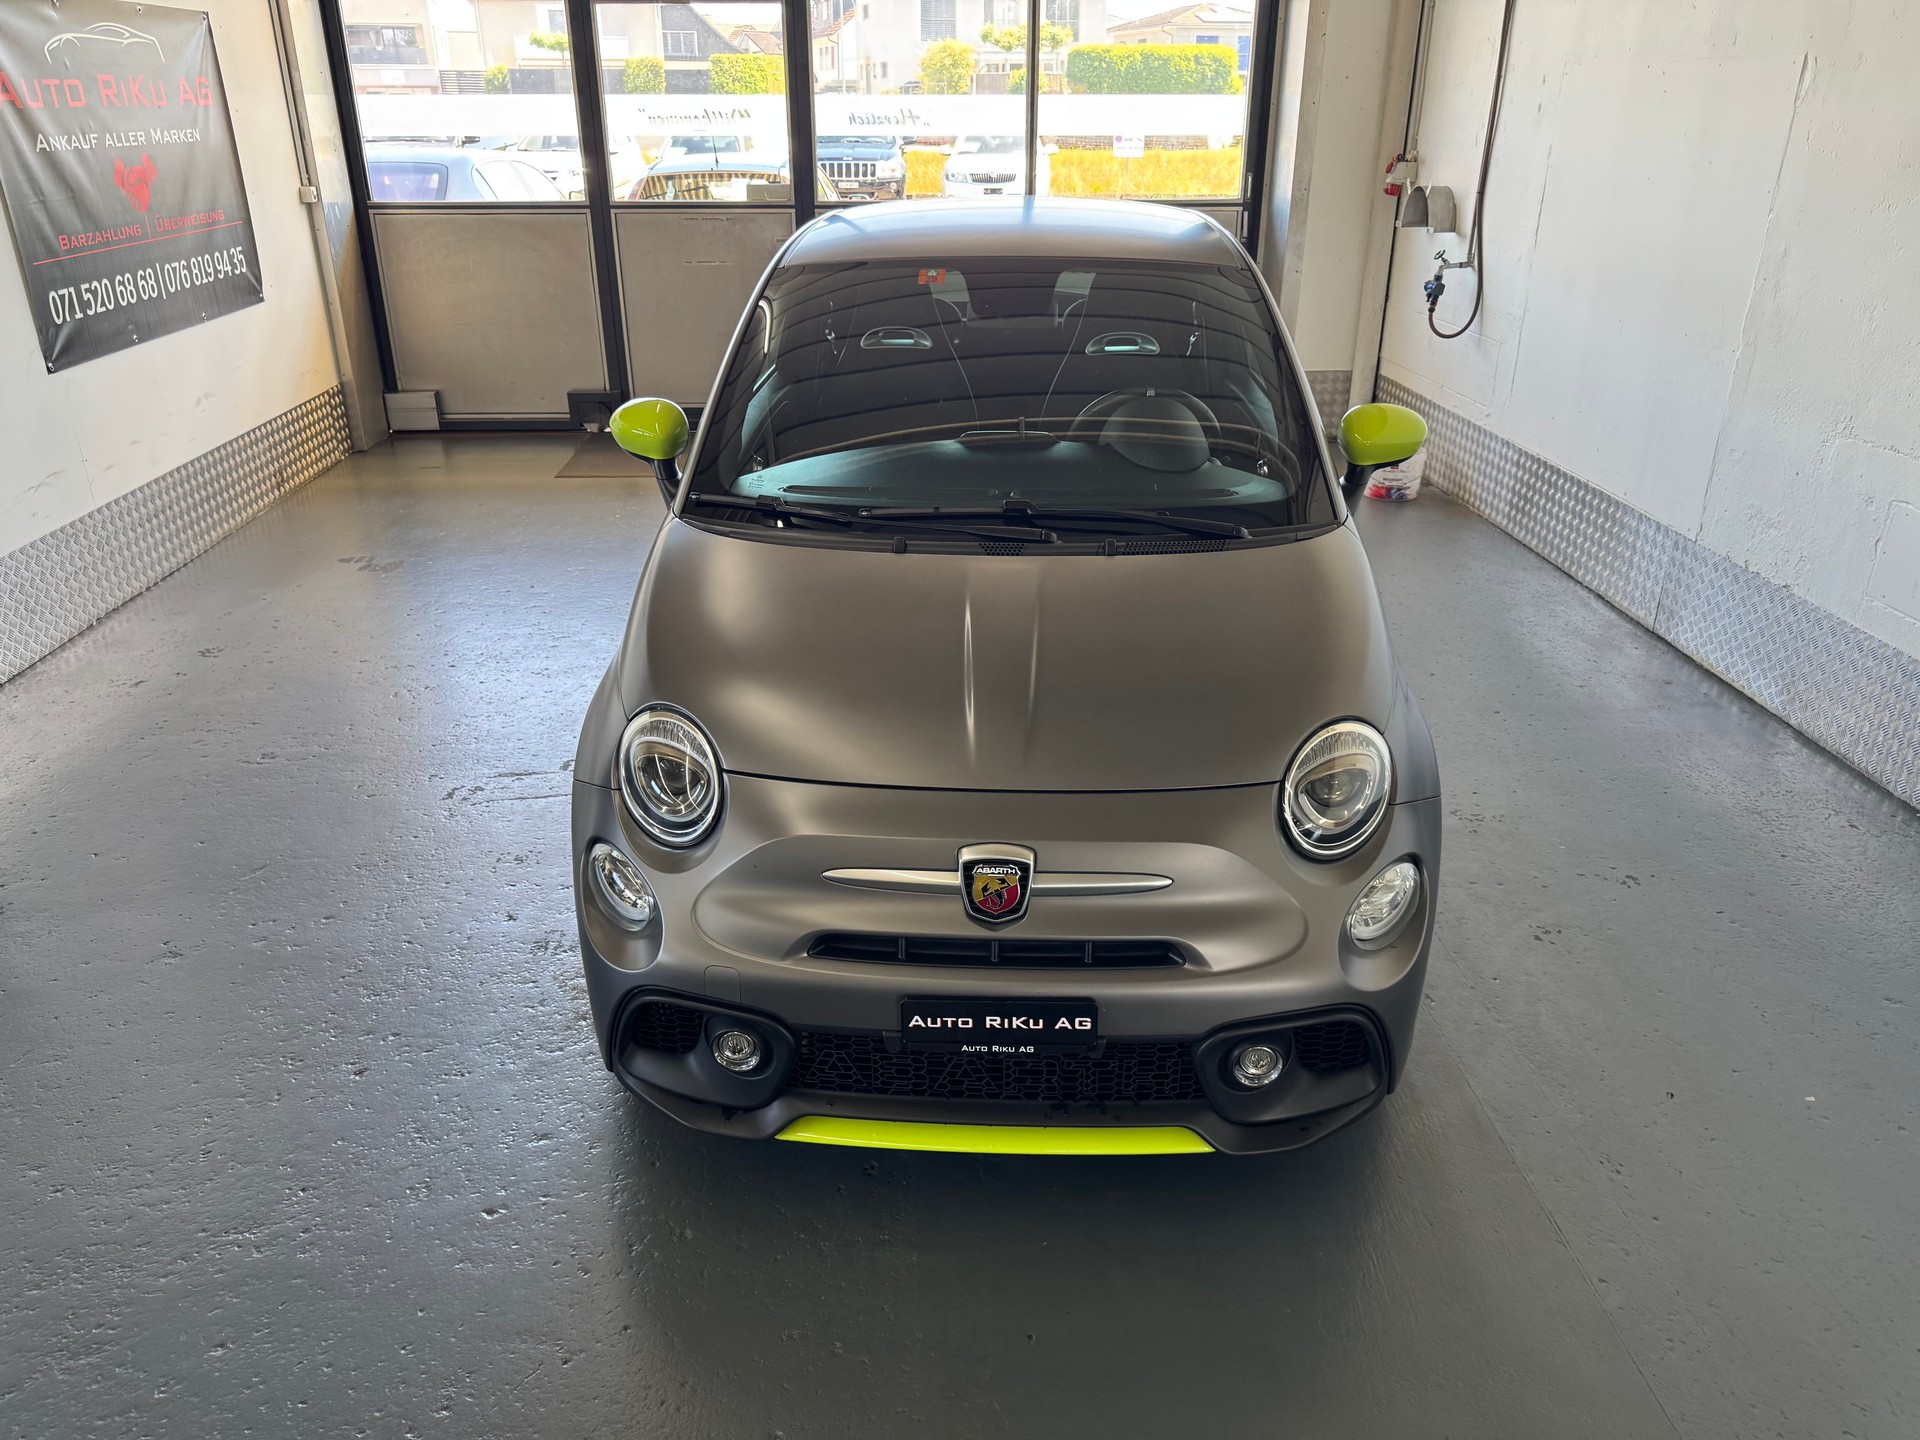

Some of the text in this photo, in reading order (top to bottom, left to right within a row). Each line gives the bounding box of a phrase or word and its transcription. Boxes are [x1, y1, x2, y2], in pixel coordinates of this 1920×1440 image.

[178, 75, 213, 106] AG
[49, 285, 83, 325] 071
[82, 278, 114, 315] 520
[115, 273, 137, 306] 68
[138, 269, 157, 300] 68
[164, 260, 190, 291] 076
[191, 253, 215, 284] 819
[215, 250, 232, 279] 94
[231, 246, 247, 275] 35
[976, 867, 1016, 875] ABARTH
[1054, 1017, 1092, 1030] AG
[1019, 1045, 1034, 1053] AG
